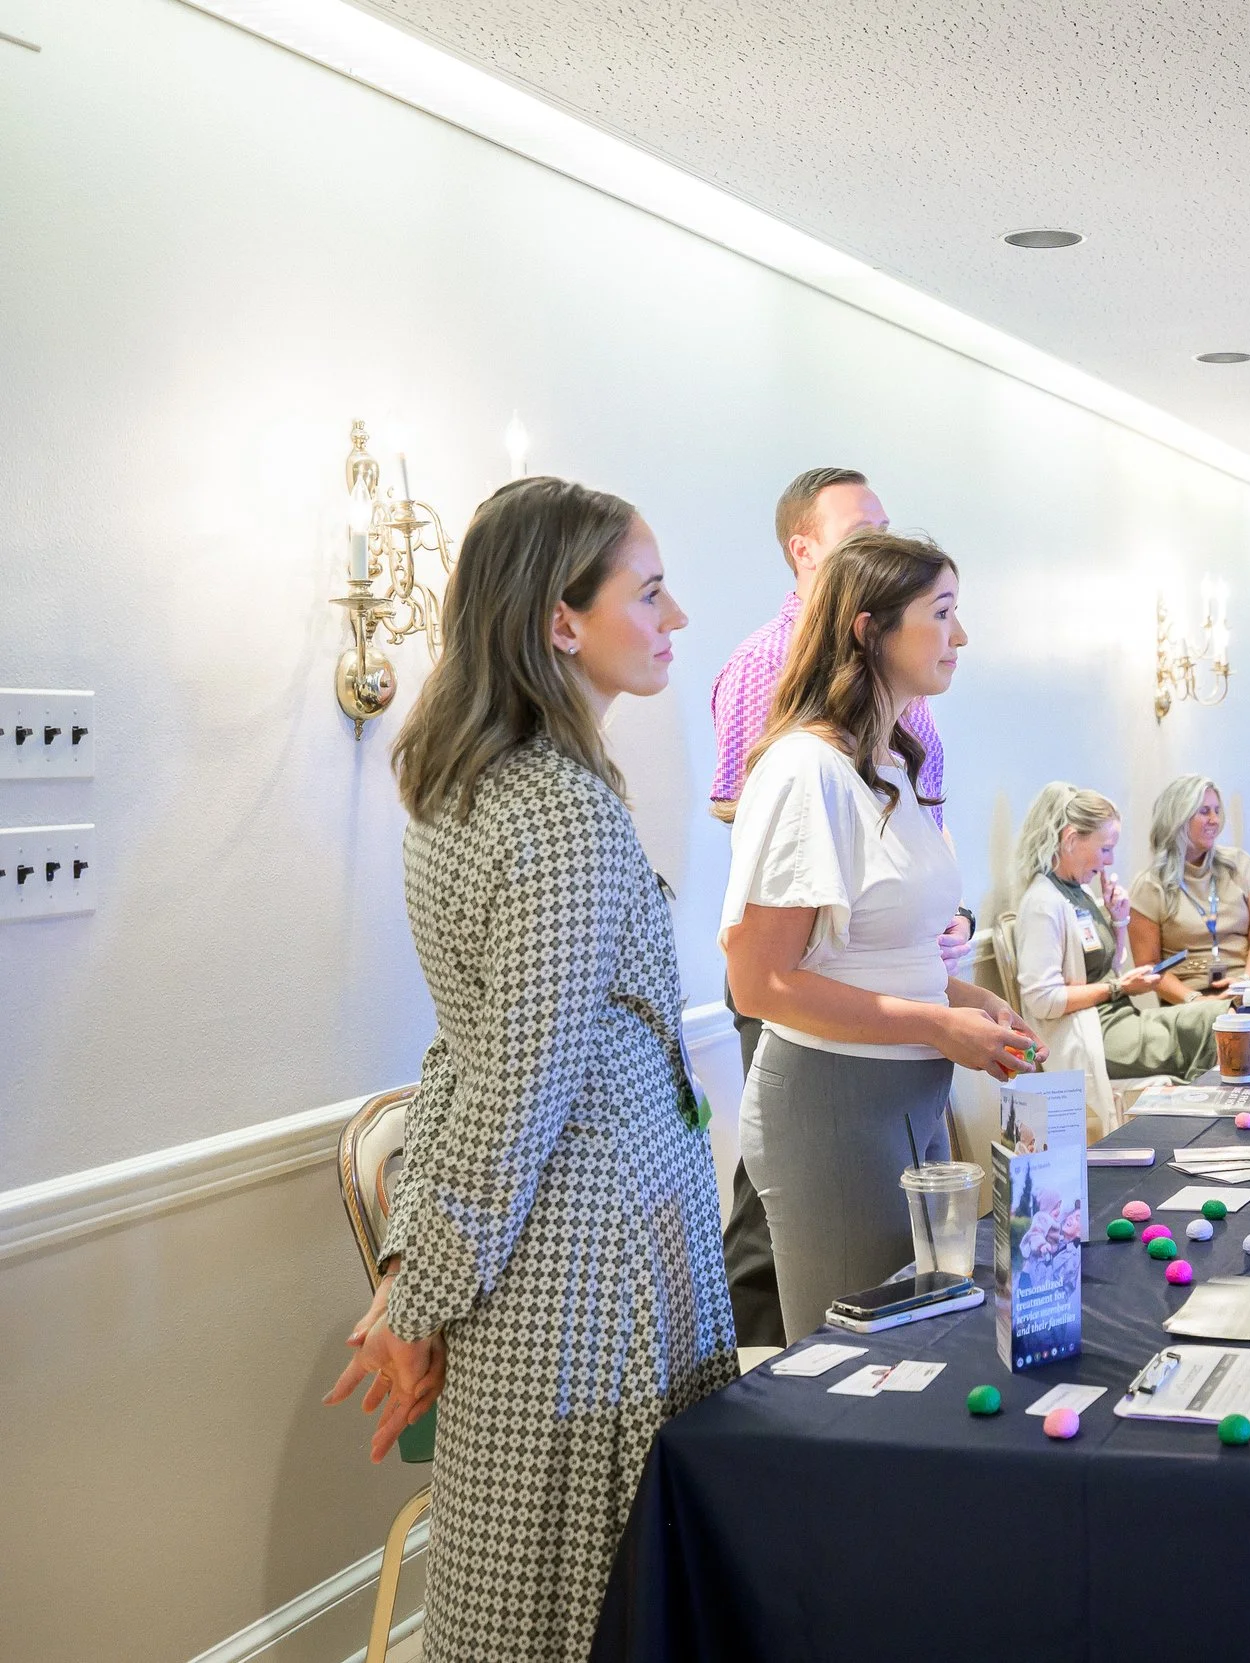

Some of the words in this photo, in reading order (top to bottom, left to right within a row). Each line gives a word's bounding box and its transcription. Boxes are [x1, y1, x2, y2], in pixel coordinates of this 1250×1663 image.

[1016, 1276, 1064, 1299] Personalized
[1016, 1294, 1053, 1312] treatment
[1054, 1289, 1066, 1301] for
[1016, 1310, 1038, 1325] service
[1040, 1302, 1071, 1318] members
[1016, 1323, 1031, 1338] and
[1031, 1320, 1047, 1333] their
[1048, 1313, 1076, 1331] families
